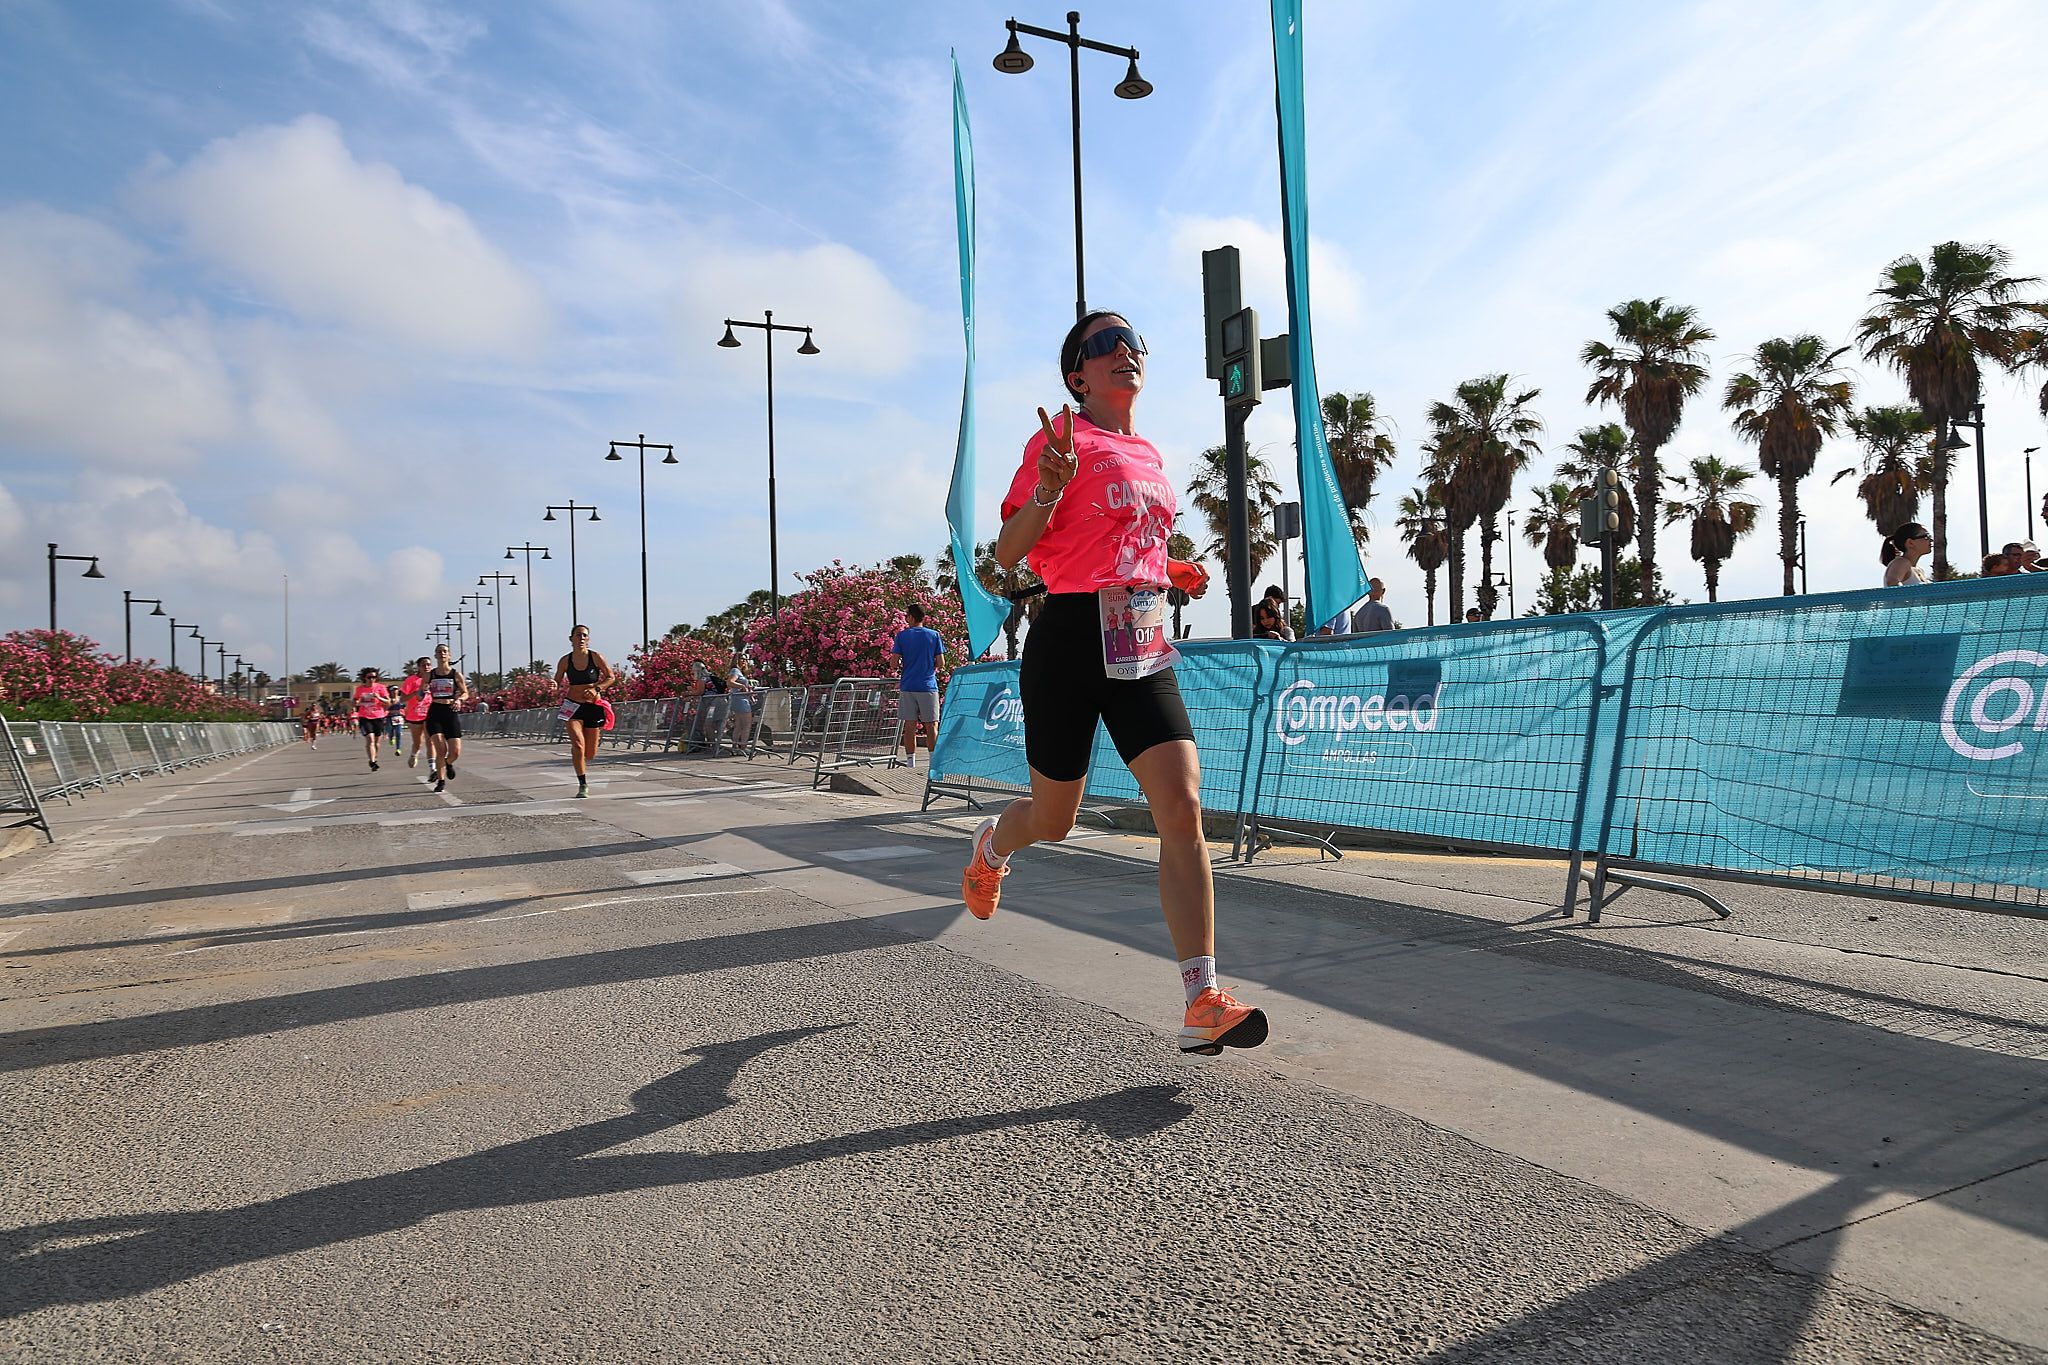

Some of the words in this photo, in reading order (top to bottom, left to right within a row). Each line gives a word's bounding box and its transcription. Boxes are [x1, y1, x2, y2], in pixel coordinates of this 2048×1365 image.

[1321, 459, 1337, 494] productos
[1106, 479, 1176, 510] CARRERA
[1276, 679, 1444, 746] Compeed
[1322, 748, 1378, 764] AMPOLLAS
